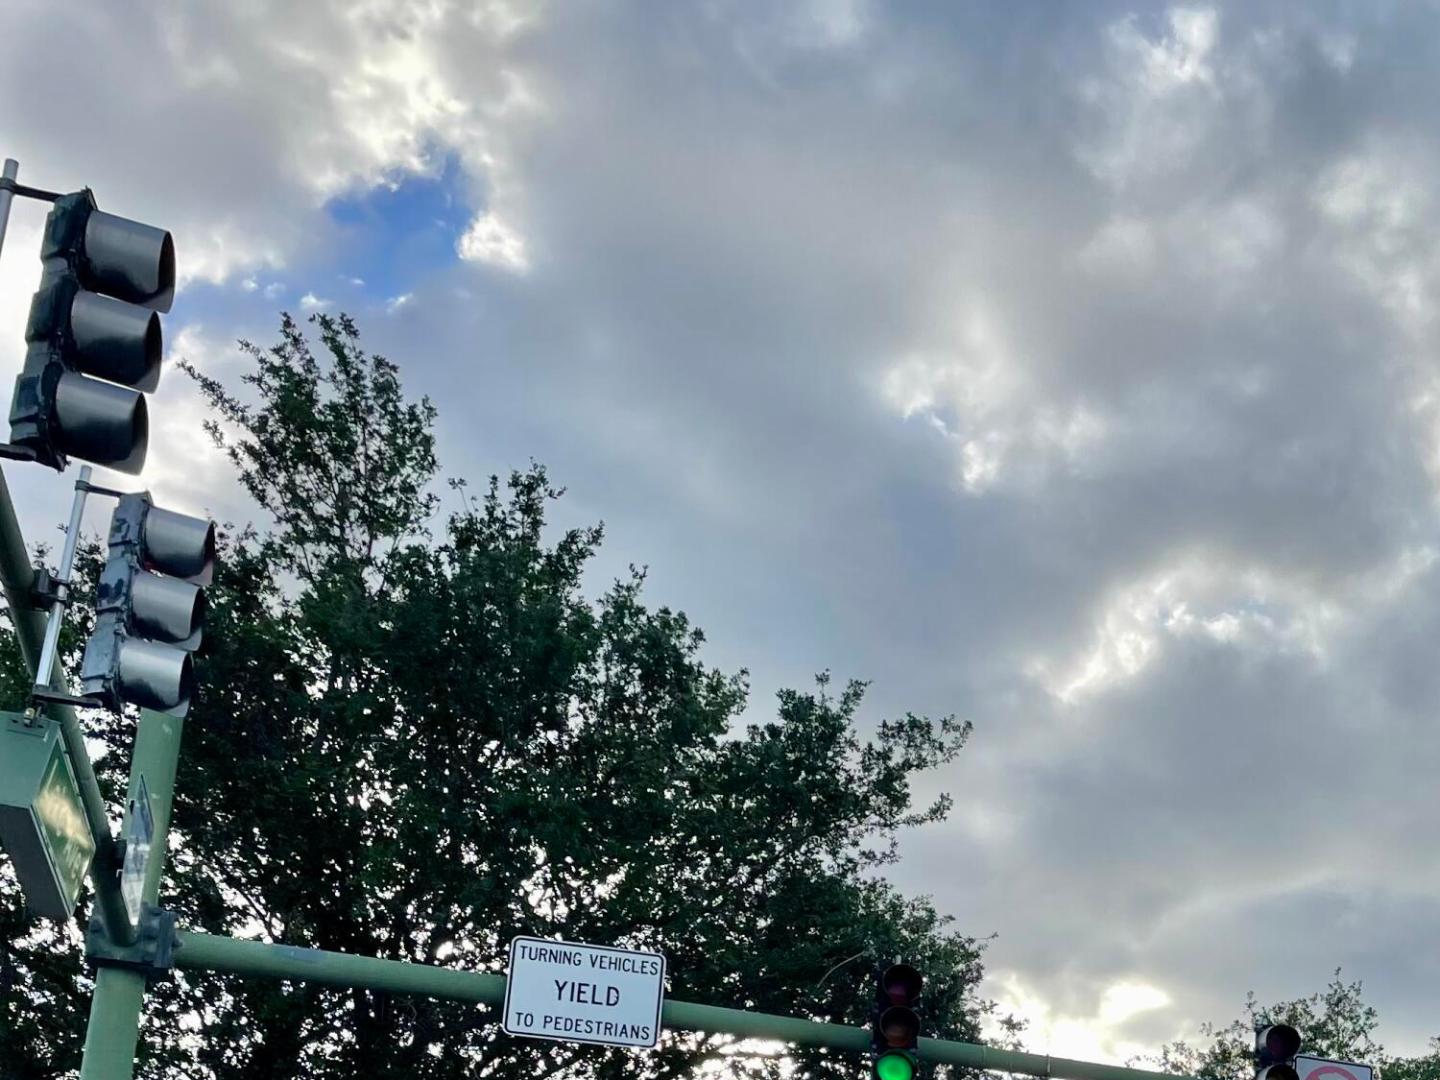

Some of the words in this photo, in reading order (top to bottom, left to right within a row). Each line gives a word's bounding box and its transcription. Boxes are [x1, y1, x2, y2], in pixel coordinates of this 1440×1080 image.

[519, 945, 582, 967] TURNING
[589, 954, 659, 976] VEHICLES
[554, 979, 620, 1007] YIELD
[515, 1012, 534, 1027] TO
[543, 1015, 650, 1040] PEDESTRIANS
